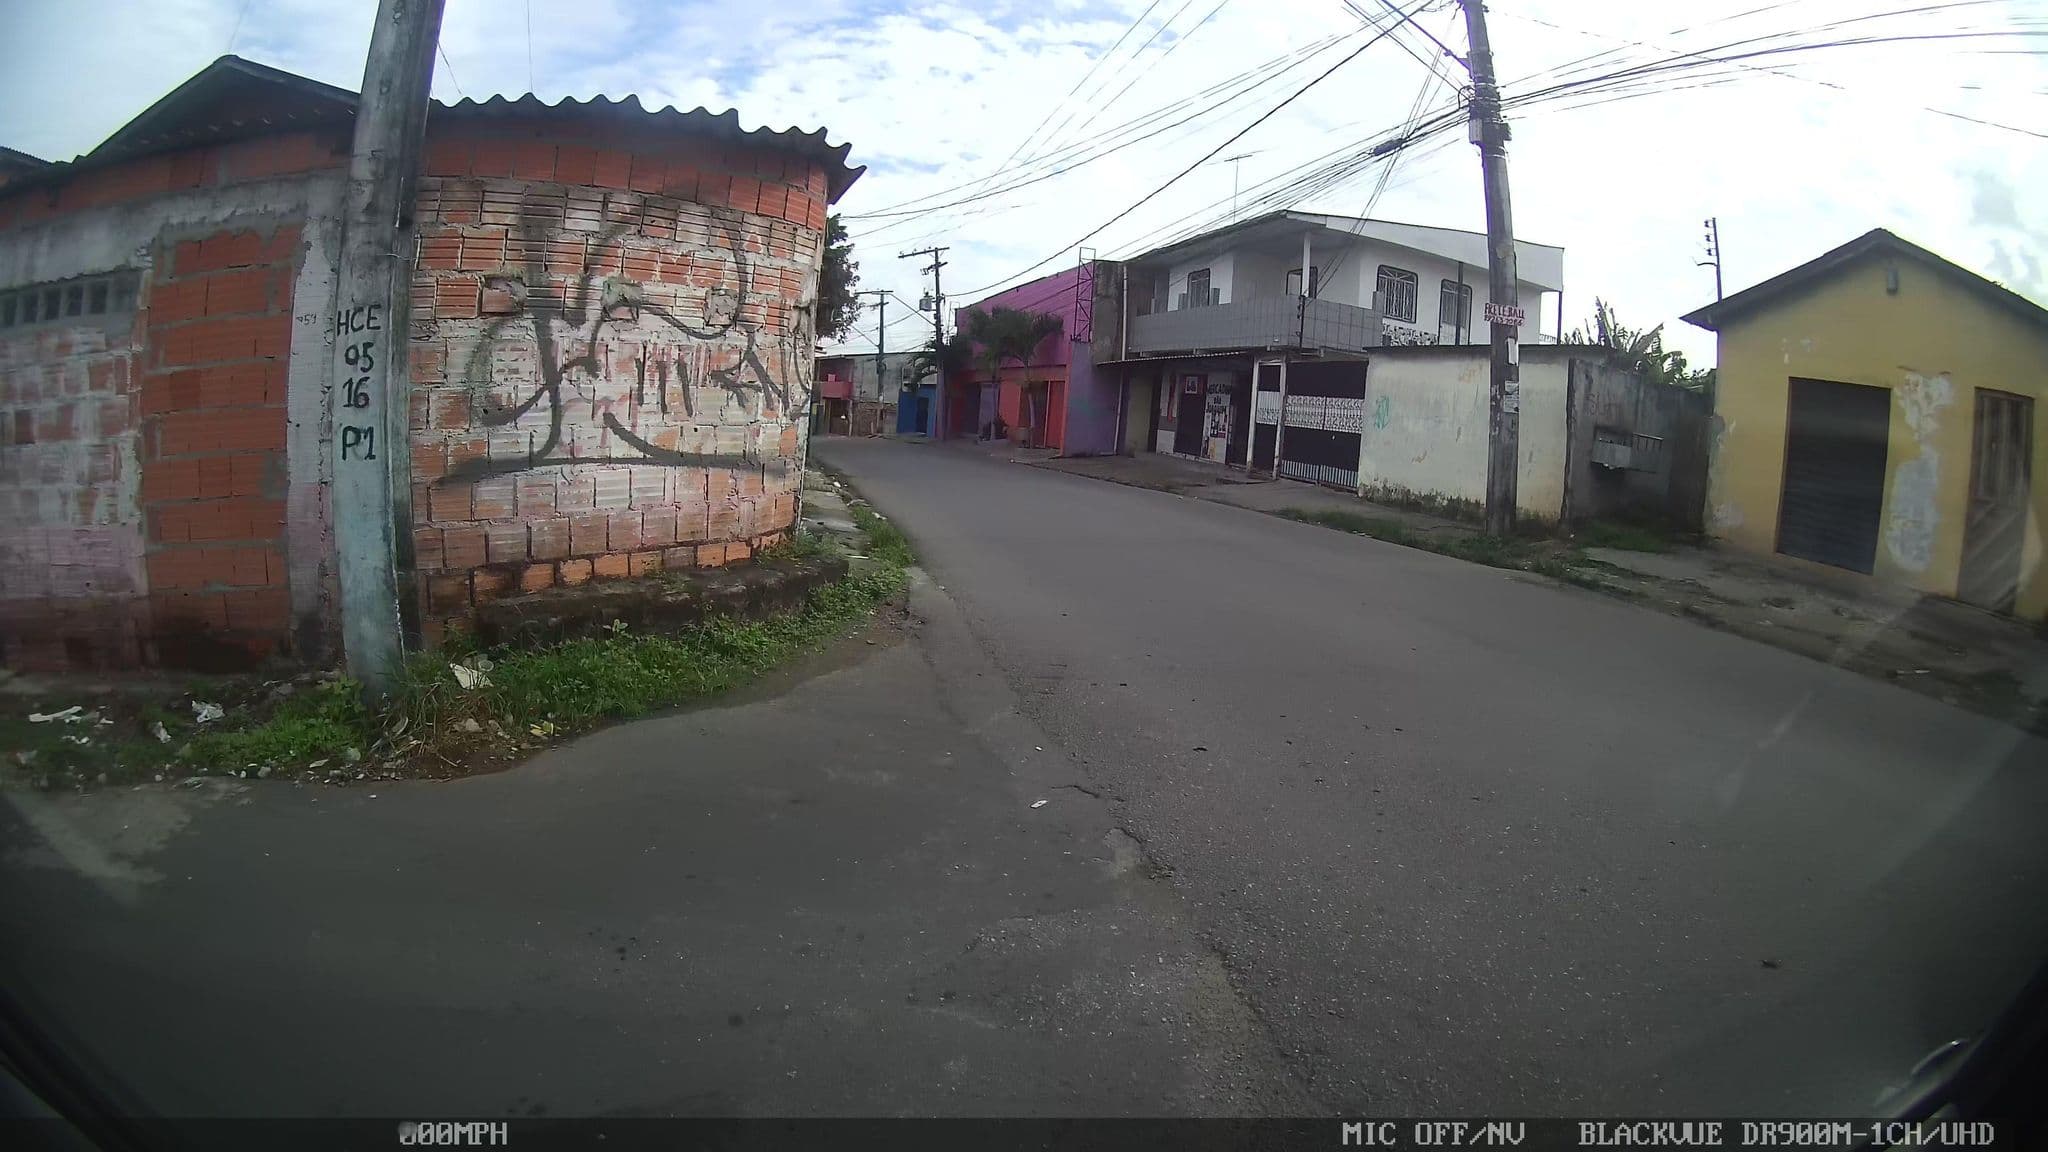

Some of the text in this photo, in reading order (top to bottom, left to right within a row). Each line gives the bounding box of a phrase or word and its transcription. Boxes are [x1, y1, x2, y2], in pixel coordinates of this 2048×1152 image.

[336, 304, 382, 336] HCE
[342, 376, 371, 409] 16
[341, 425, 377, 461] P1
